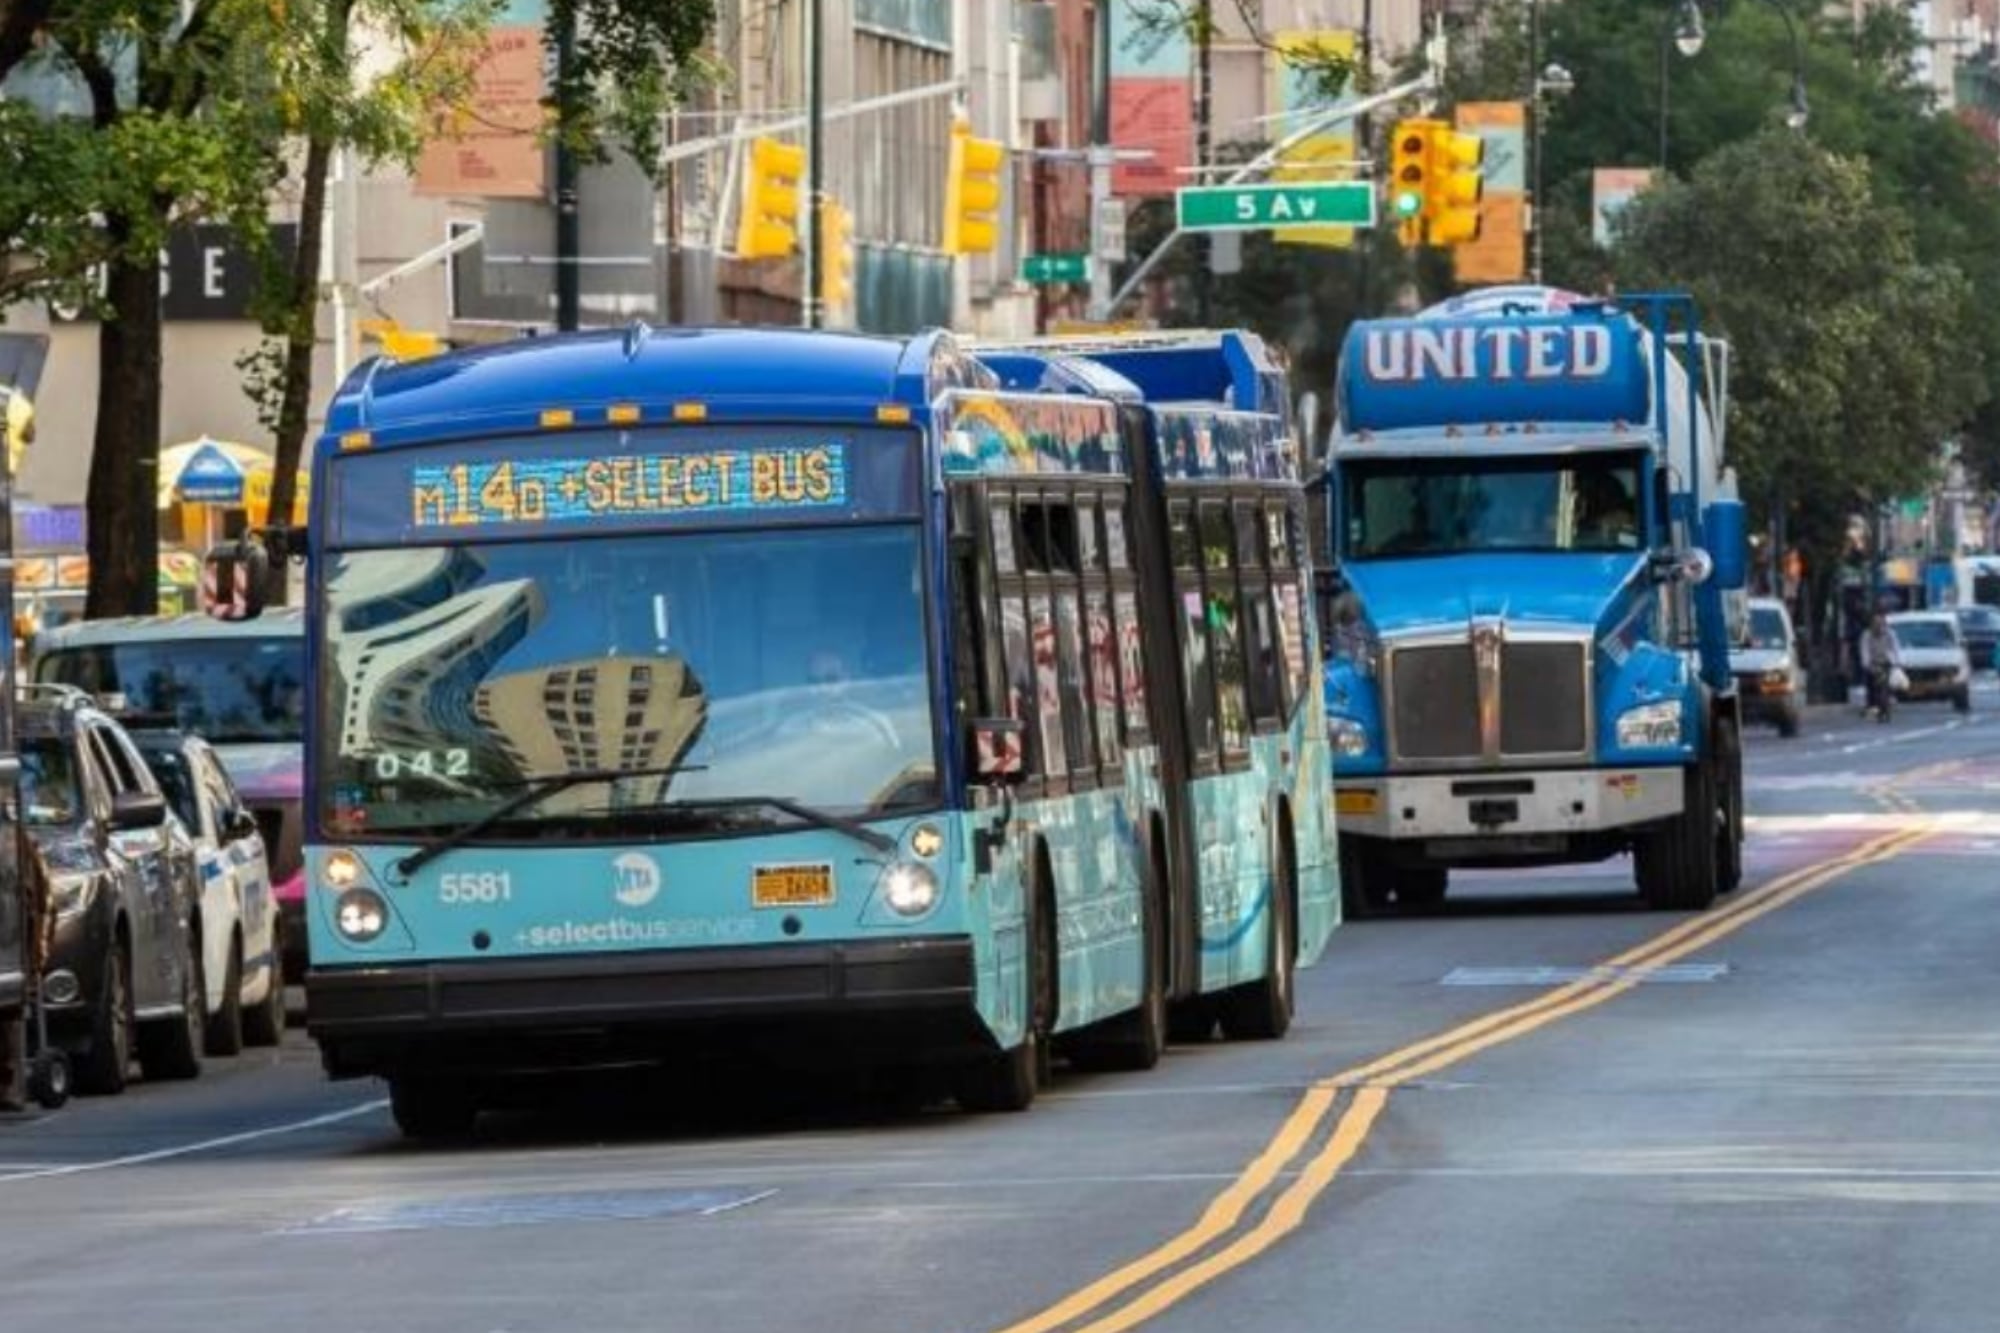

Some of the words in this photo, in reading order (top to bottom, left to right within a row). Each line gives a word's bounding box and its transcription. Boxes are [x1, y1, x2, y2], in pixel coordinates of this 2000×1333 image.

[1236, 194, 1257, 219] 5
[1270, 193, 1317, 218] Av
[1365, 324, 1613, 381] UNITED
[414, 460, 545, 526] M14D
[752, 449, 833, 503] BUS
[440, 872, 511, 903] 5581
